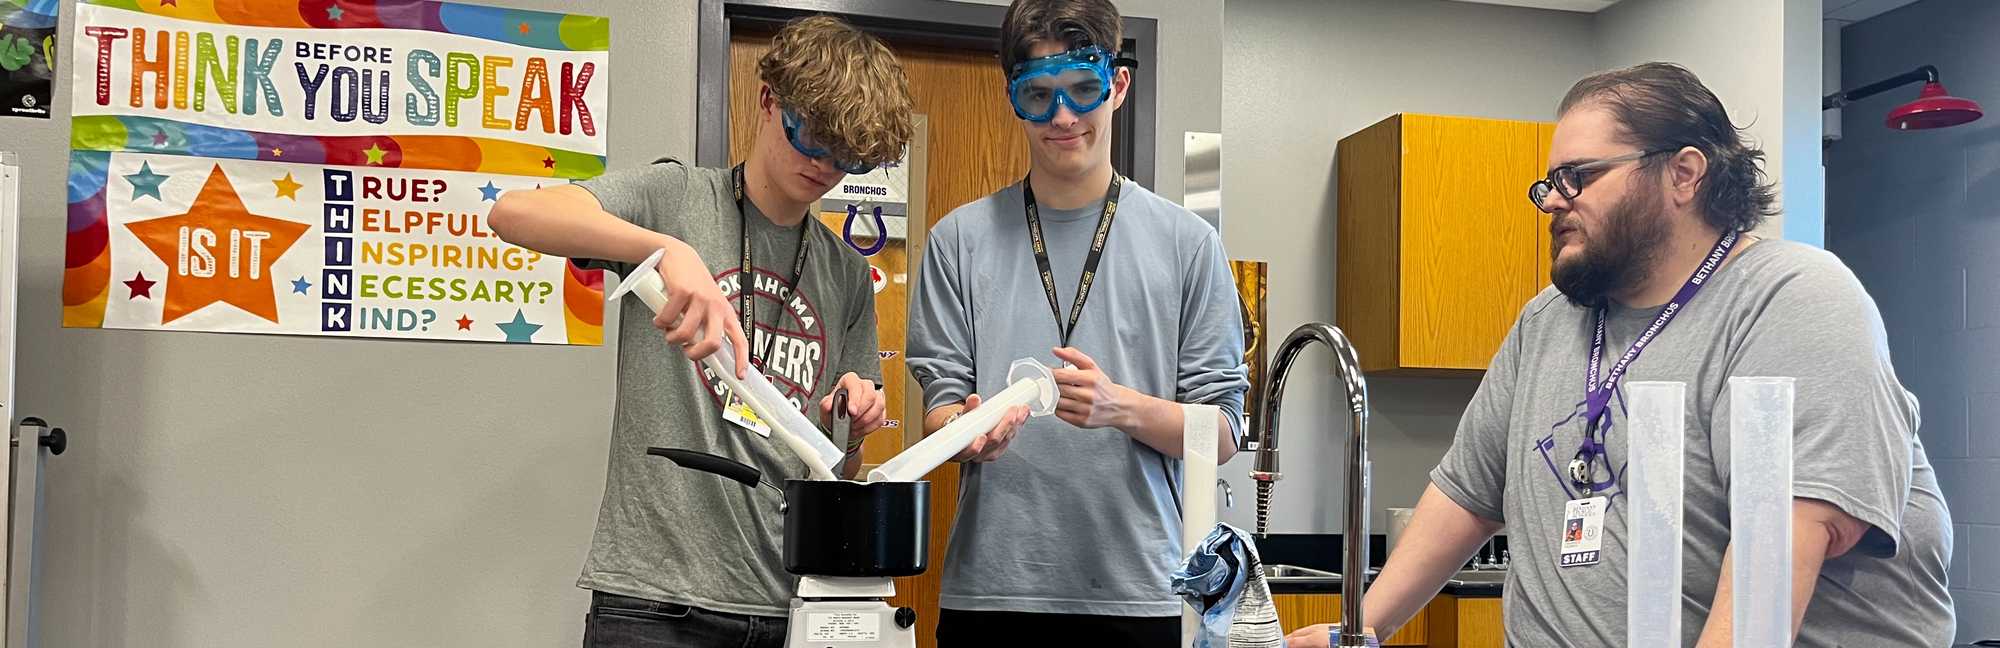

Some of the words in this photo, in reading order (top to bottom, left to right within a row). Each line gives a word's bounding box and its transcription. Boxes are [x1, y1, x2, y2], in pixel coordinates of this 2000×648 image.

[85, 26, 284, 117] THINK
[295, 41, 393, 64] BEFORE
[294, 62, 390, 125] YOU
[405, 49, 596, 137] SPEAK
[843, 184, 887, 196] BRONCHOS
[178, 226, 217, 278] IS
[229, 228, 271, 280] IT
[1691, 246, 1726, 285] BETHANY
[718, 273, 815, 330] OKAHOMA
[753, 328, 821, 394] NERS
[1605, 347, 1637, 389] BETHANY
[1563, 551, 1596, 564] STAFF
